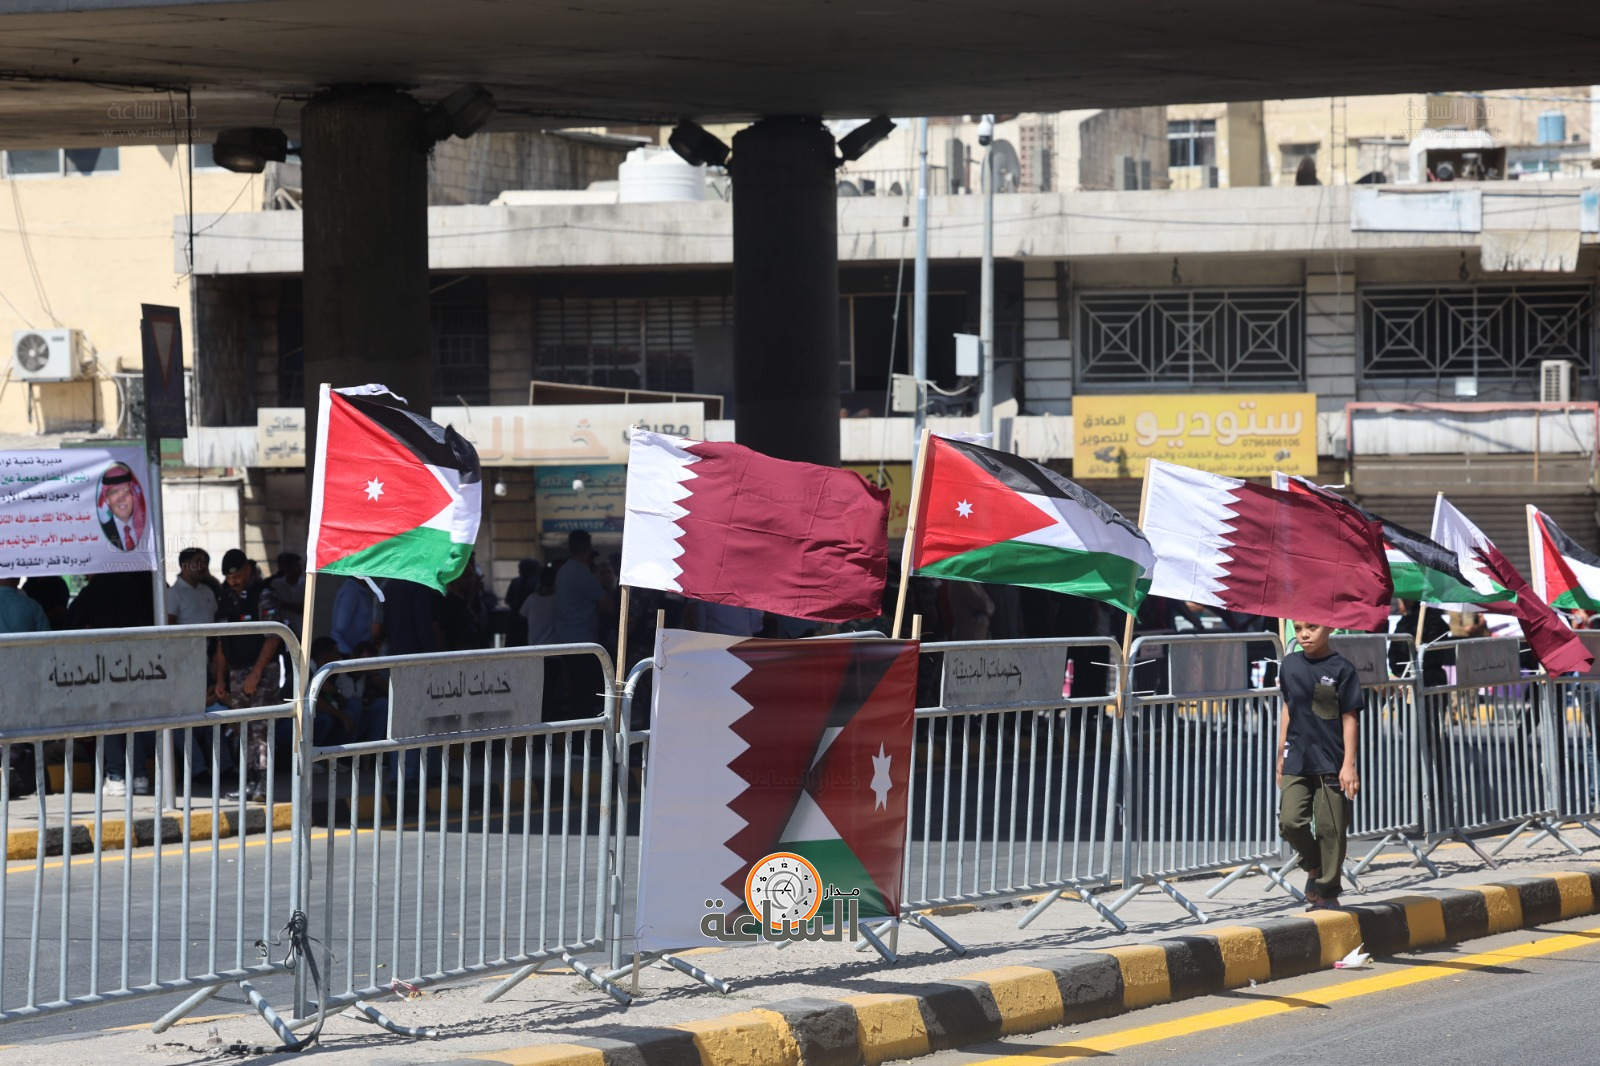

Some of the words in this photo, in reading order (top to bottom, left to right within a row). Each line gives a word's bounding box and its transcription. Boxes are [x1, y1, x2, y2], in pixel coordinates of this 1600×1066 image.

[1083, 414, 1126, 429] الصادق
[1134, 399, 1303, 447] ستوديو
[37, 456, 62, 467] مديرية
[109, 653, 167, 682] خدمات
[468, 670, 512, 696] خدمات
